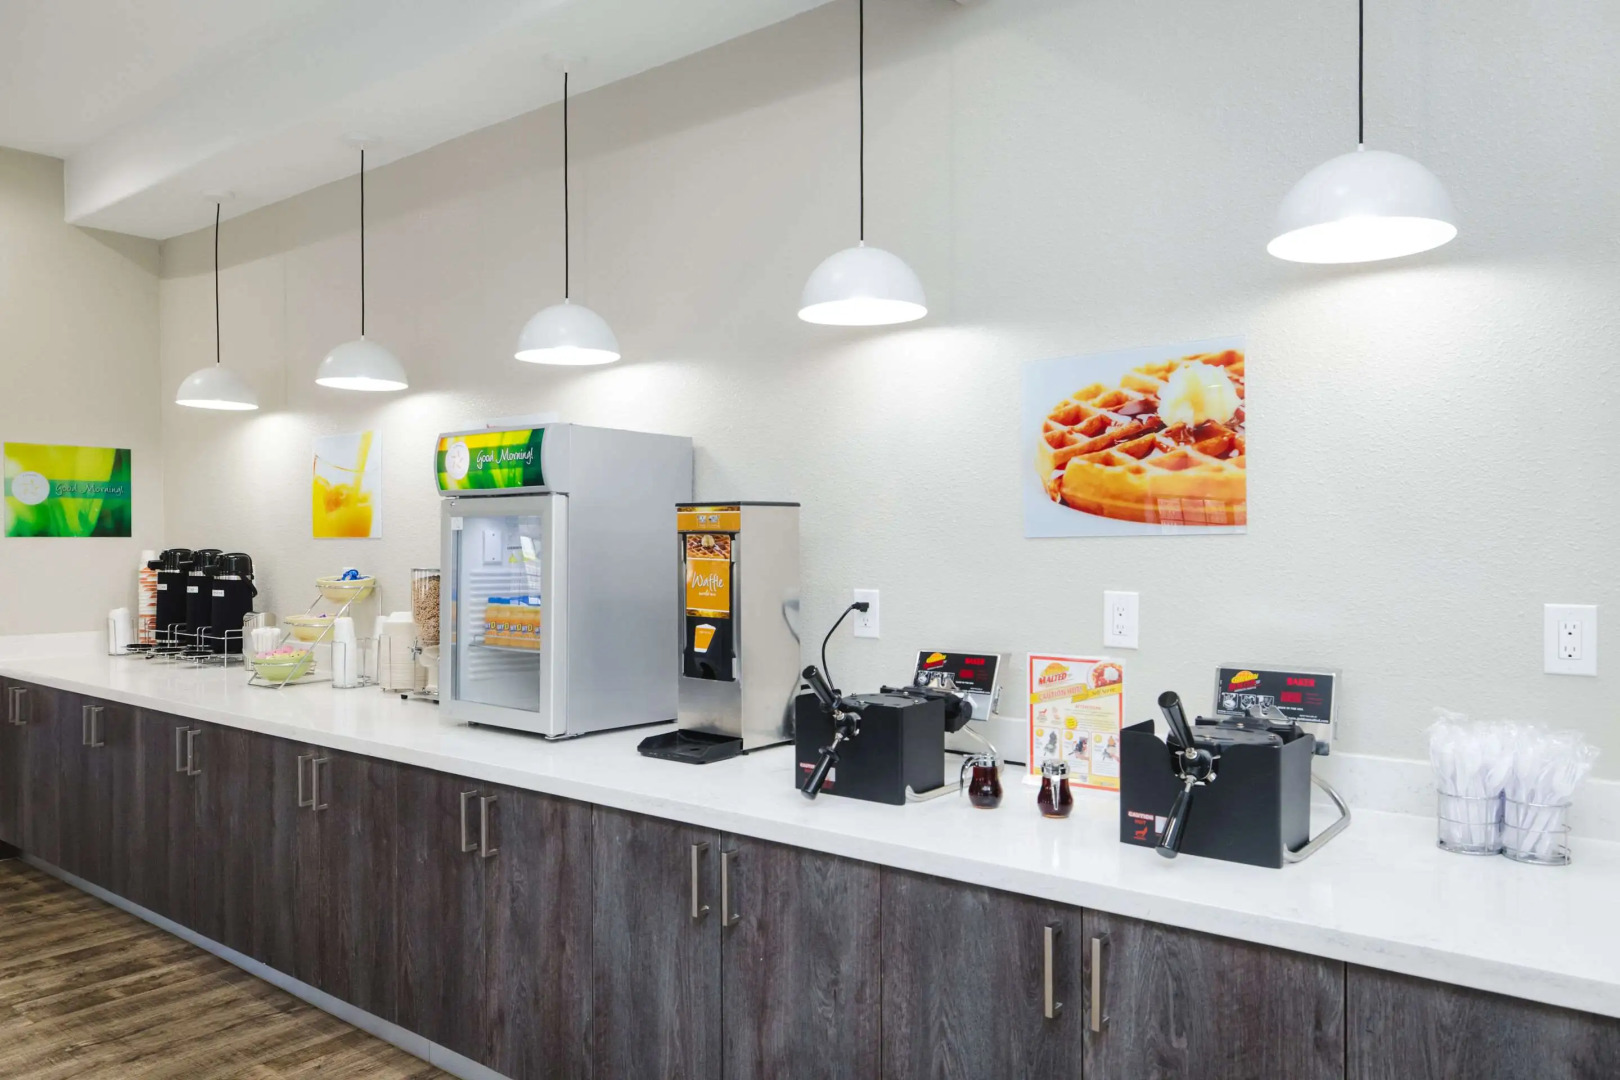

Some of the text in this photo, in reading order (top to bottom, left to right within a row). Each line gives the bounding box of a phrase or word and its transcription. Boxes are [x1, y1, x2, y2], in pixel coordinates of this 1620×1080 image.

[477, 447, 534, 469] Good Morning!
[55, 483, 124, 496] Good Morning!
[691, 570, 724, 592] Waffle
[1038, 671, 1067, 685] MALTED
[1286, 677, 1315, 687] BAKER
